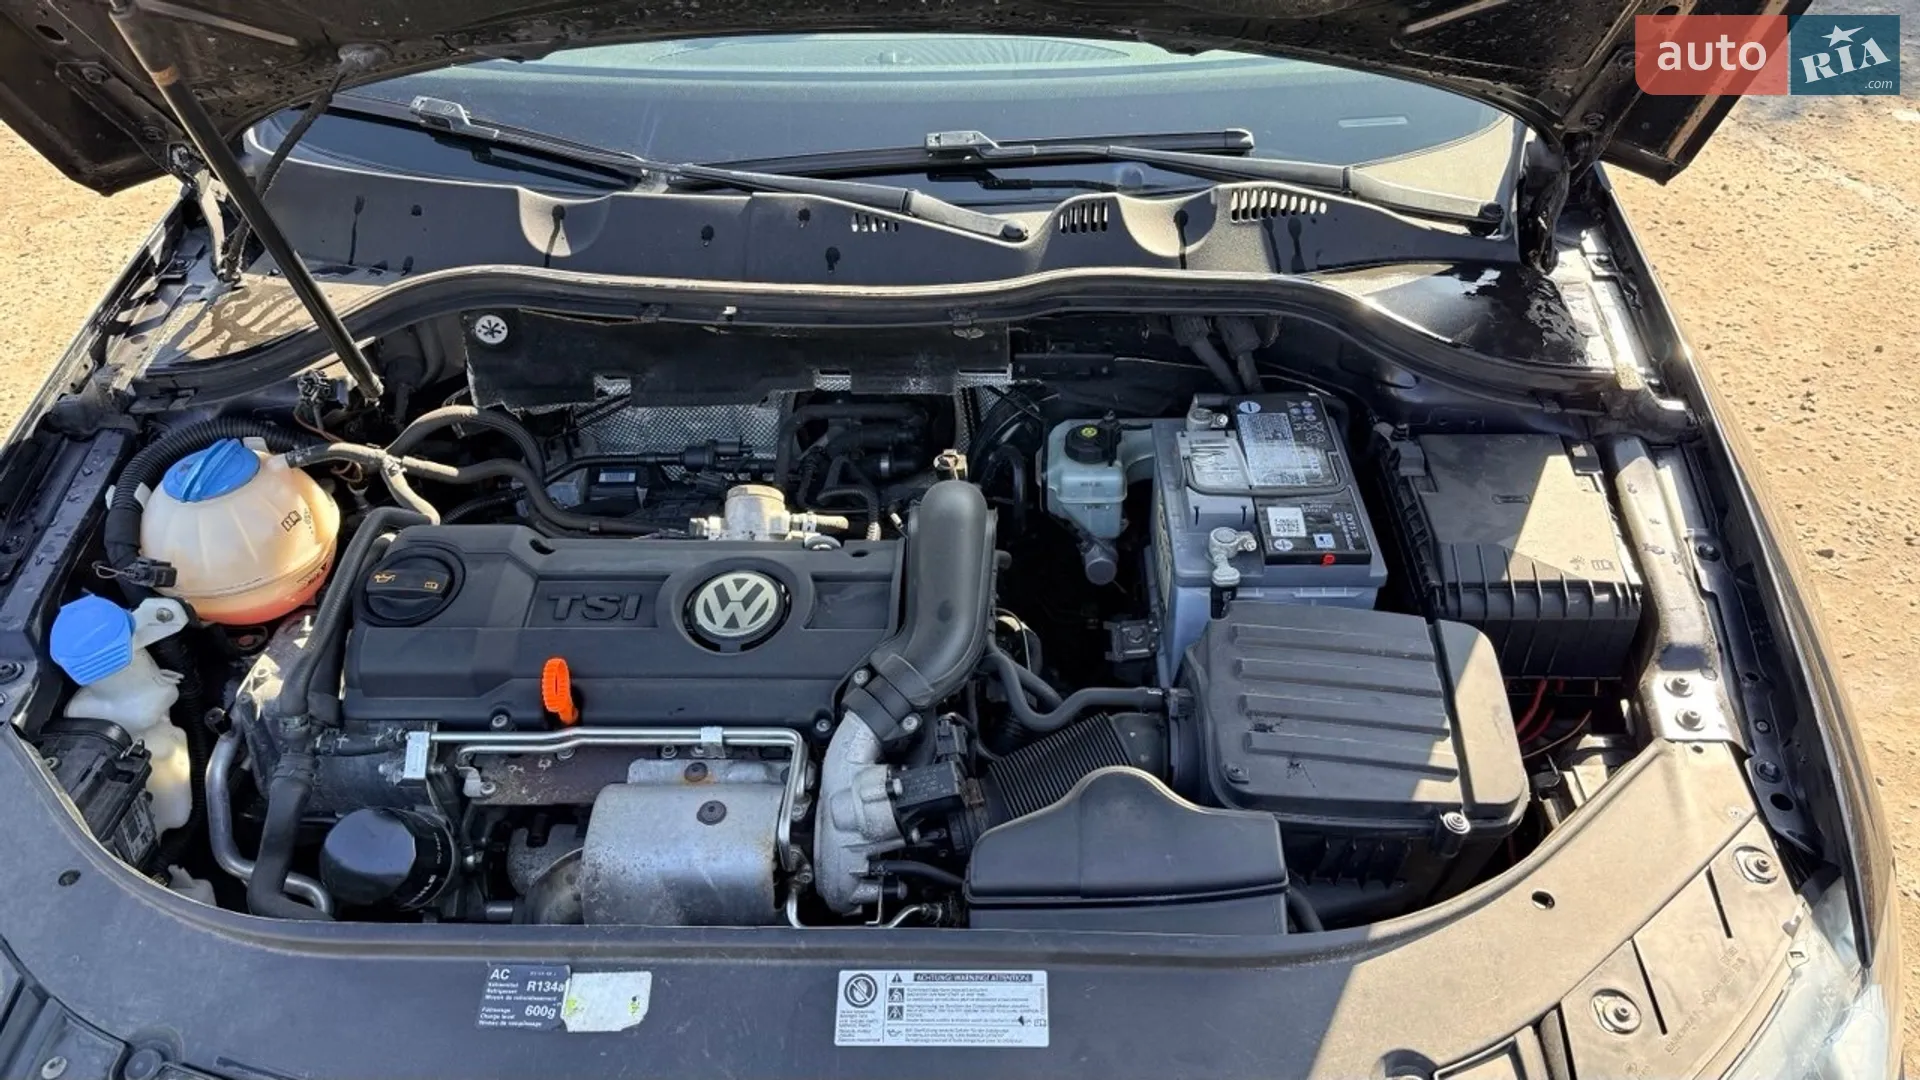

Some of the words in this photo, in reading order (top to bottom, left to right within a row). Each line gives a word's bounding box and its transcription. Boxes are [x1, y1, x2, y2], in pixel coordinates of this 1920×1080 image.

[548, 593, 643, 621] TSI
[490, 969, 511, 980] AC
[525, 1005, 556, 1019] 600g
